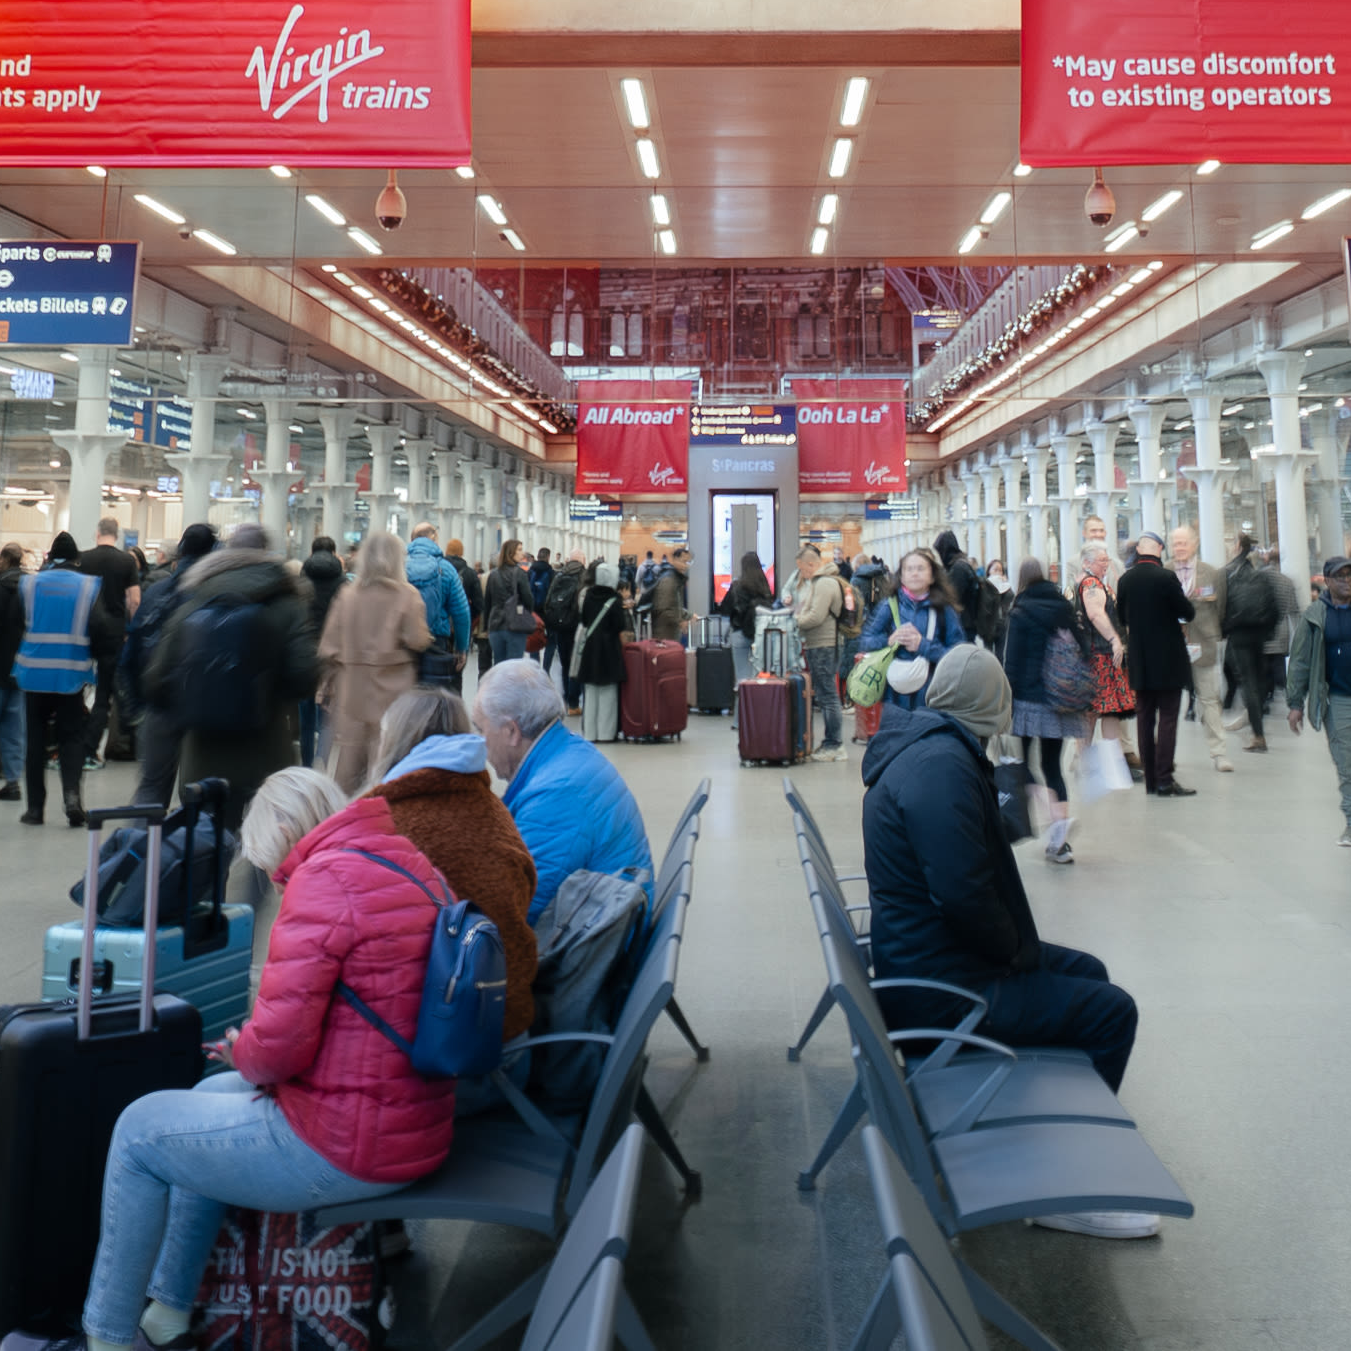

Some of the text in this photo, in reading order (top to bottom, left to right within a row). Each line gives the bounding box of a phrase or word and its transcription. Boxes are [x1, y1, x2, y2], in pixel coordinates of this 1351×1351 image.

[245, 5, 384, 123] Virgin
[1124, 57, 1196, 76] cause
[1202, 52, 1336, 75] discomfort
[32, 85, 101, 112] apply
[341, 79, 431, 109] trains
[1068, 83, 1332, 111] to existing operators
[40, 298, 89, 314] Billets
[584, 407, 609, 424] All
[798, 407, 833, 424] Ooh
[836, 407, 857, 424] La
[725, 458, 775, 472] Pancras
[271, 1248, 298, 1277] IS
[302, 1248, 353, 1278] NOT
[276, 1285, 352, 1317] FOOD
